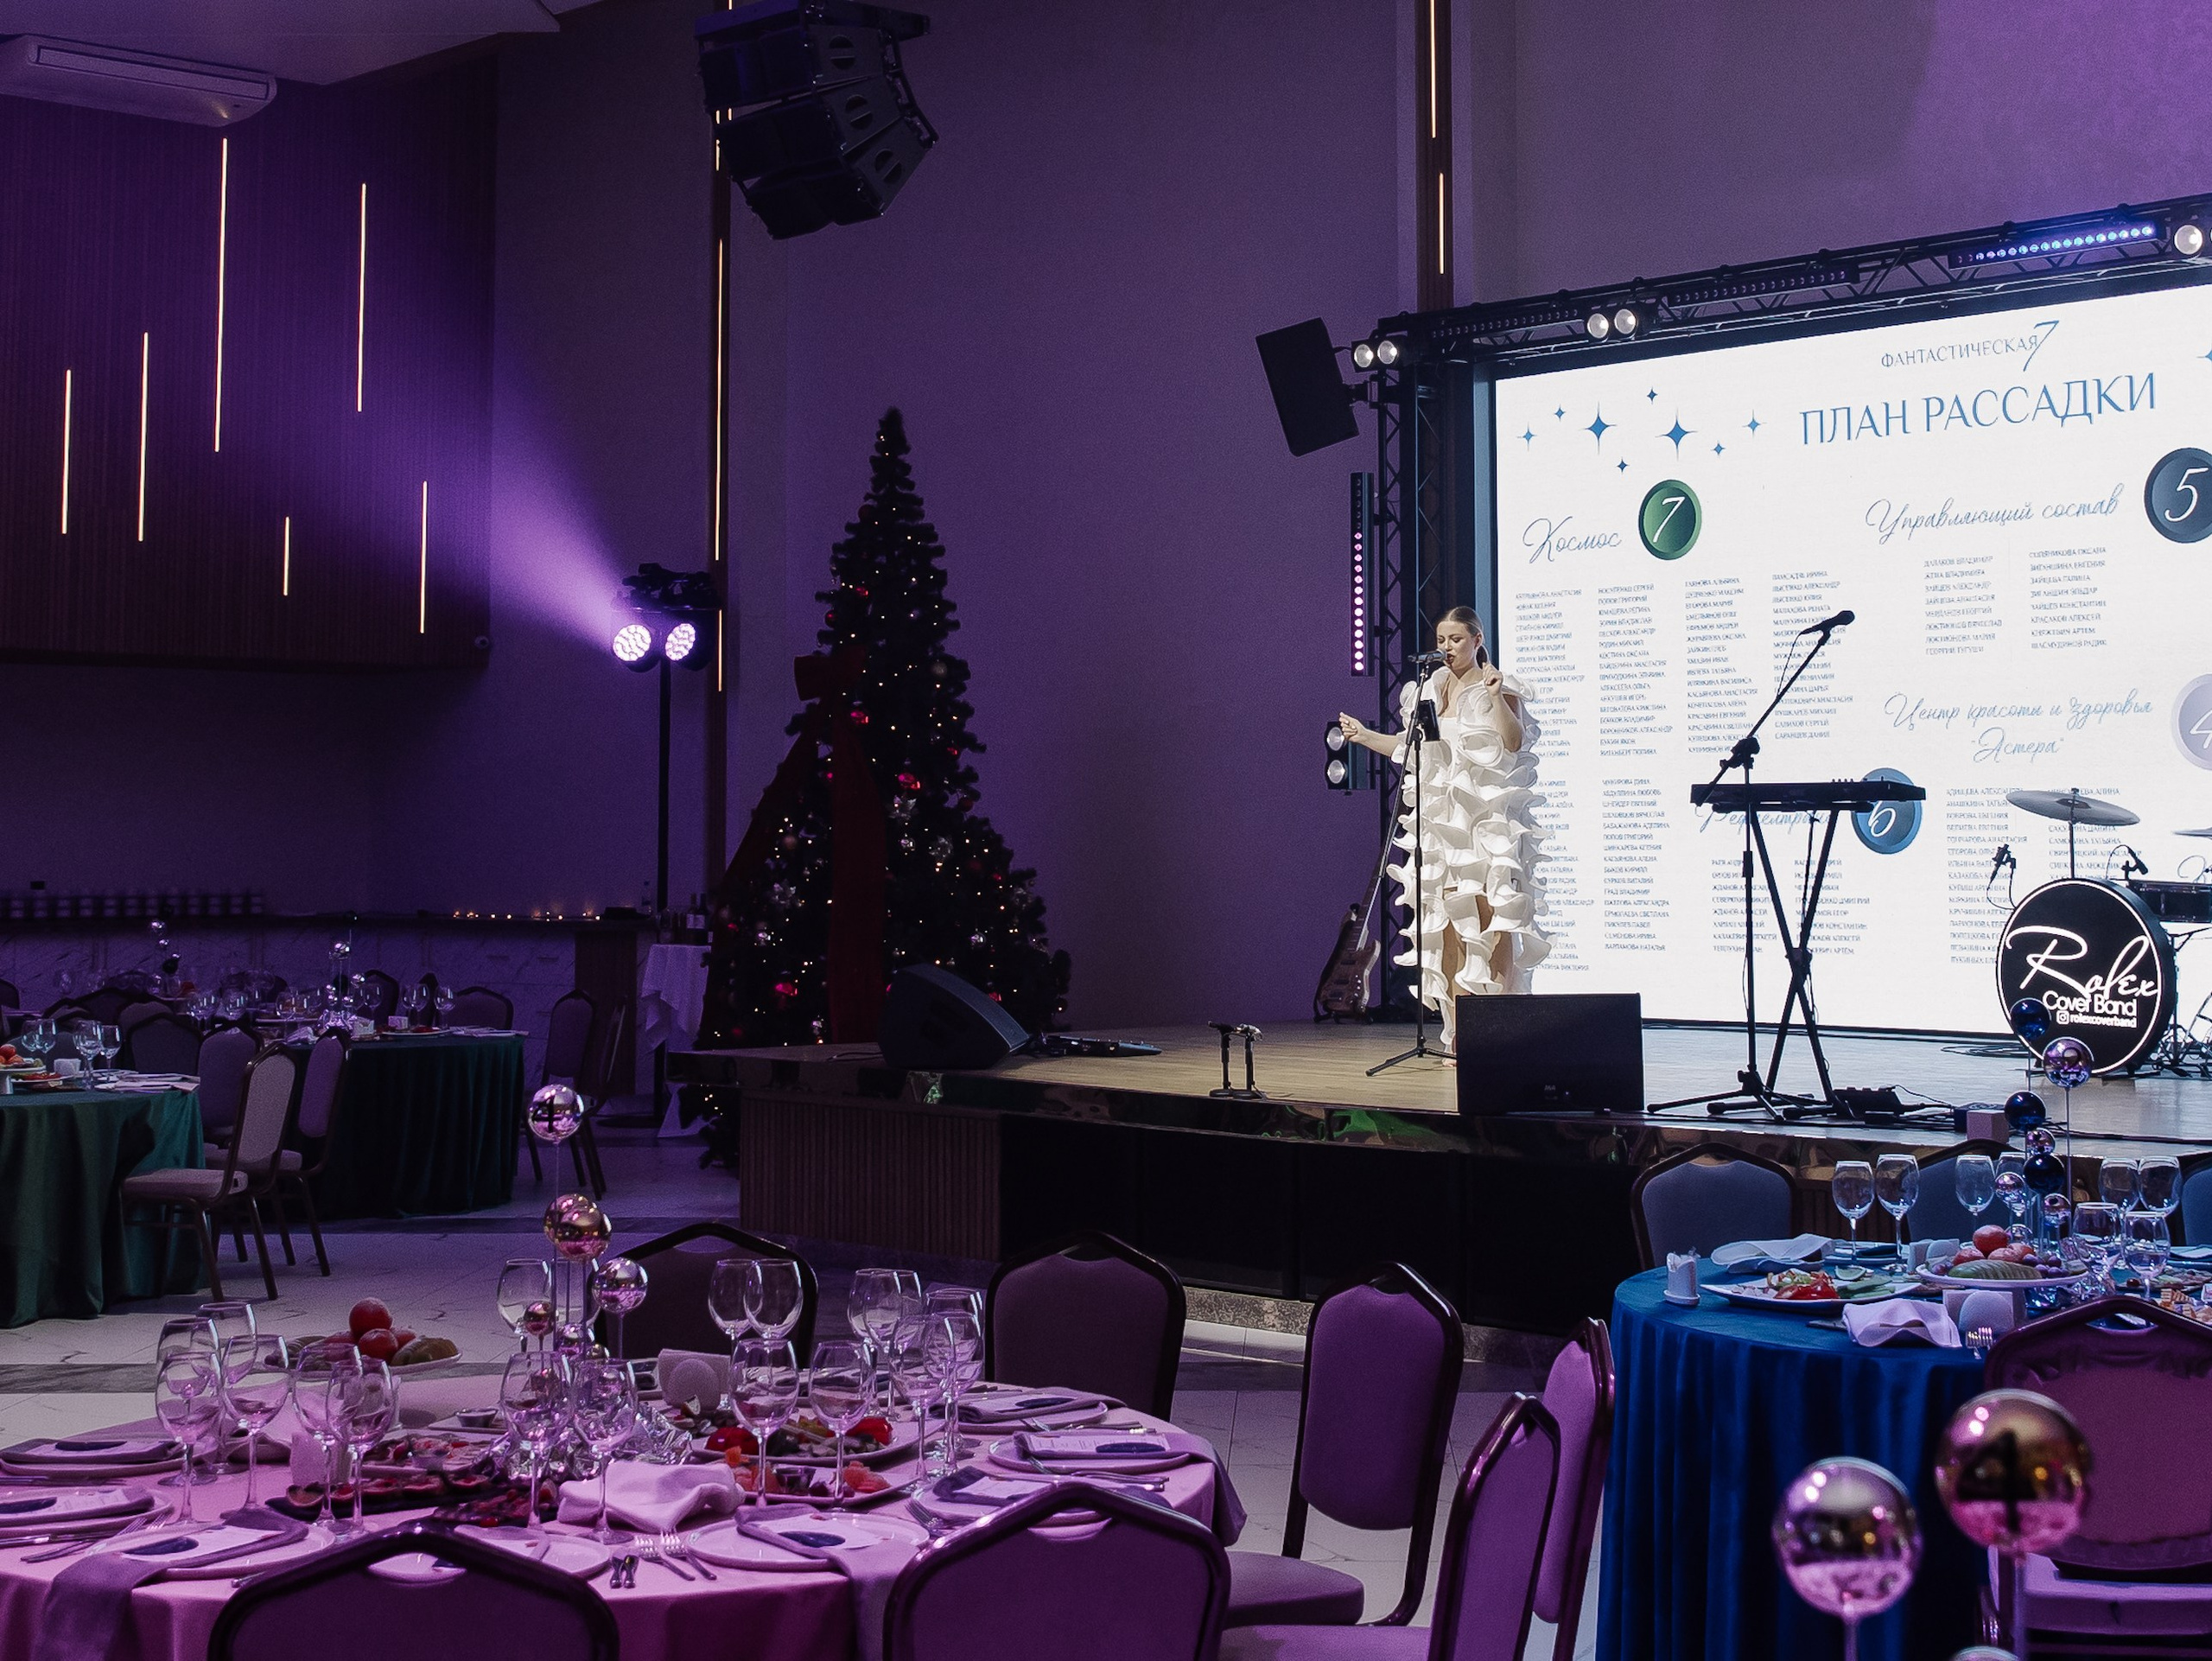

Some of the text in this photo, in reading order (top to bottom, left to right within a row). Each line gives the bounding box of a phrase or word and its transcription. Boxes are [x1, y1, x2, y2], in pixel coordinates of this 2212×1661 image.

[1882, 320, 2060, 372] ФАНТАСТИЧЕСКАЯ 7
[1800, 372, 2157, 445] ПЛАН РАССАДКИ
[1865, 482, 2126, 545] Управляющий состав
[2164, 467, 2209, 522] 5
[1522, 496, 1686, 563] Космос 7
[1885, 693, 1960, 731] Центр
[1967, 703, 2043, 728] красоты
[2005, 926, 2158, 999] Rolex
[2043, 990, 2138, 1017] Cover Band
[2069, 1012, 2138, 1028] rolexcoverband
